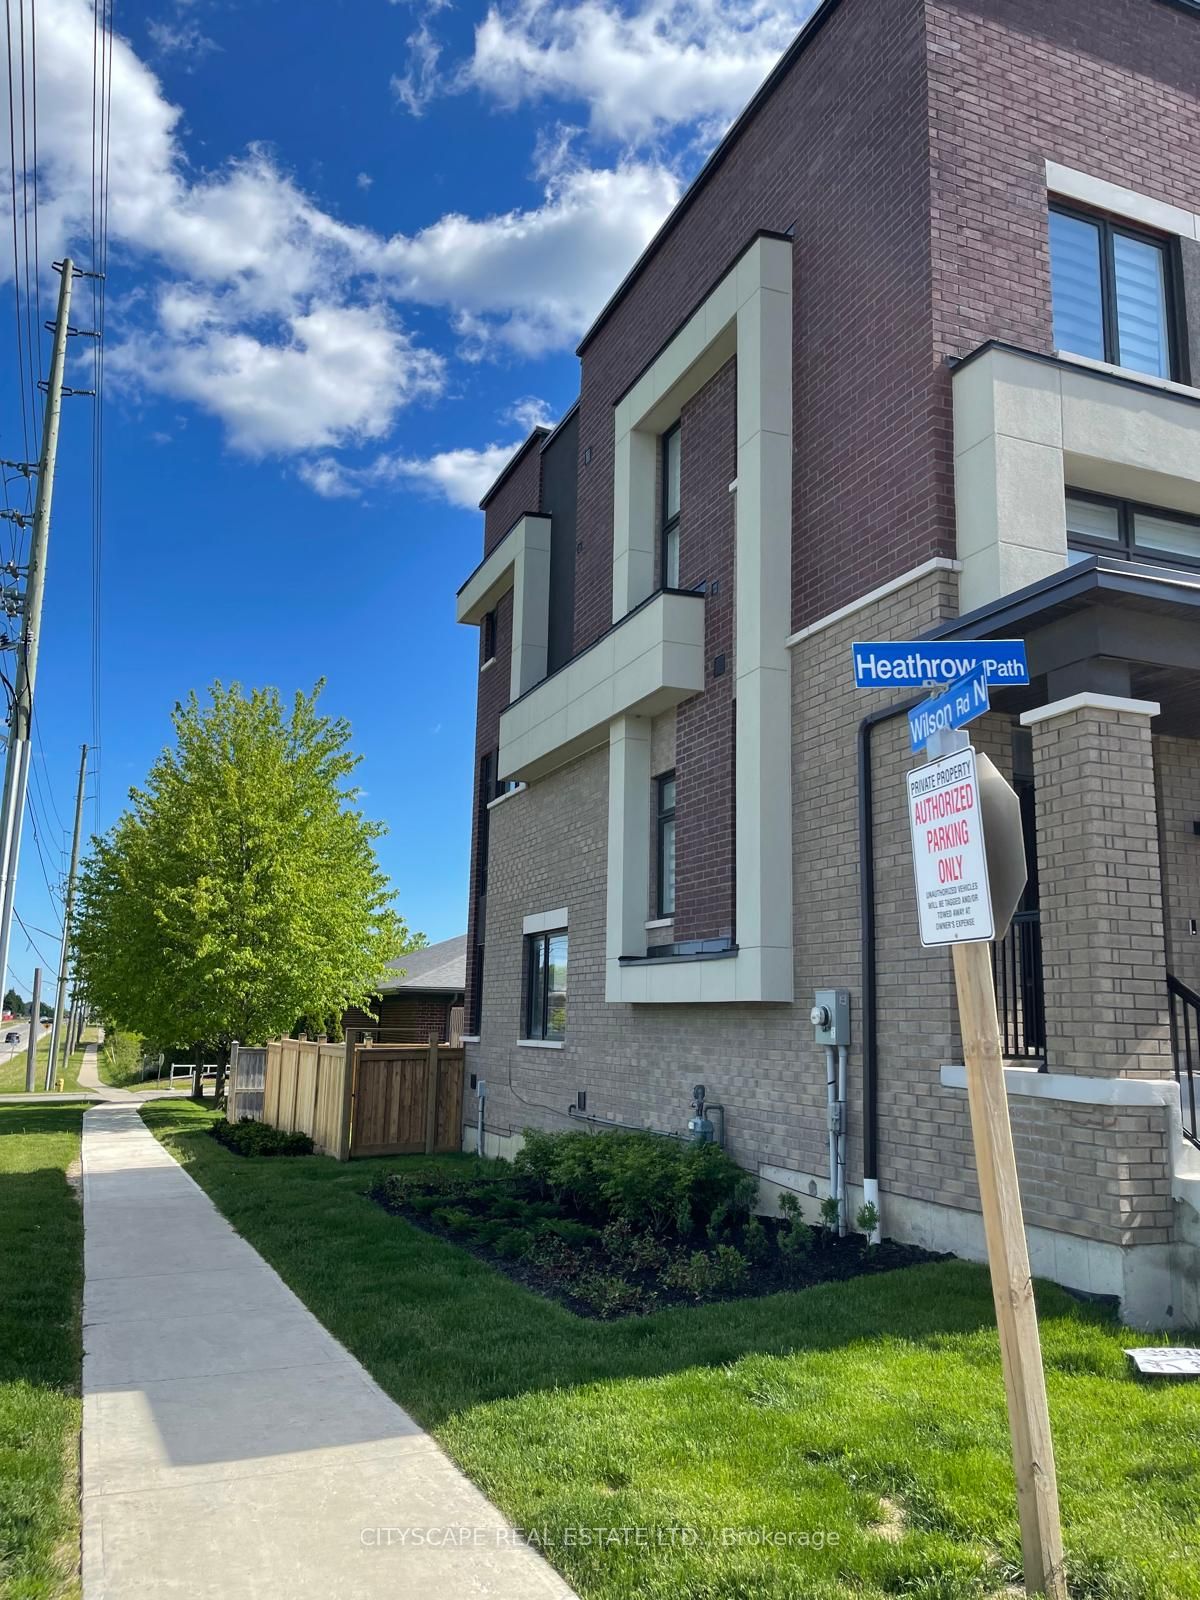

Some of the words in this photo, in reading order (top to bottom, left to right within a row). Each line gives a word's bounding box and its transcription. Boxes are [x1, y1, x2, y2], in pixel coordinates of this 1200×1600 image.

[856, 653, 976, 679] Heathrow
[986, 659, 1025, 677] Path
[910, 703, 953, 743] Wilson
[956, 693, 970, 717] Rd
[973, 674, 986, 707] N
[910, 774, 936, 796] PRIVATE
[936, 760, 971, 785] PROPERTY
[915, 783, 974, 826] AUTHORIZED
[926, 819, 969, 854] PARKING
[938, 854, 963, 884] ONLY
[958, 882, 978, 893] VEHICLES
[956, 918, 975, 928] EXPENSE
